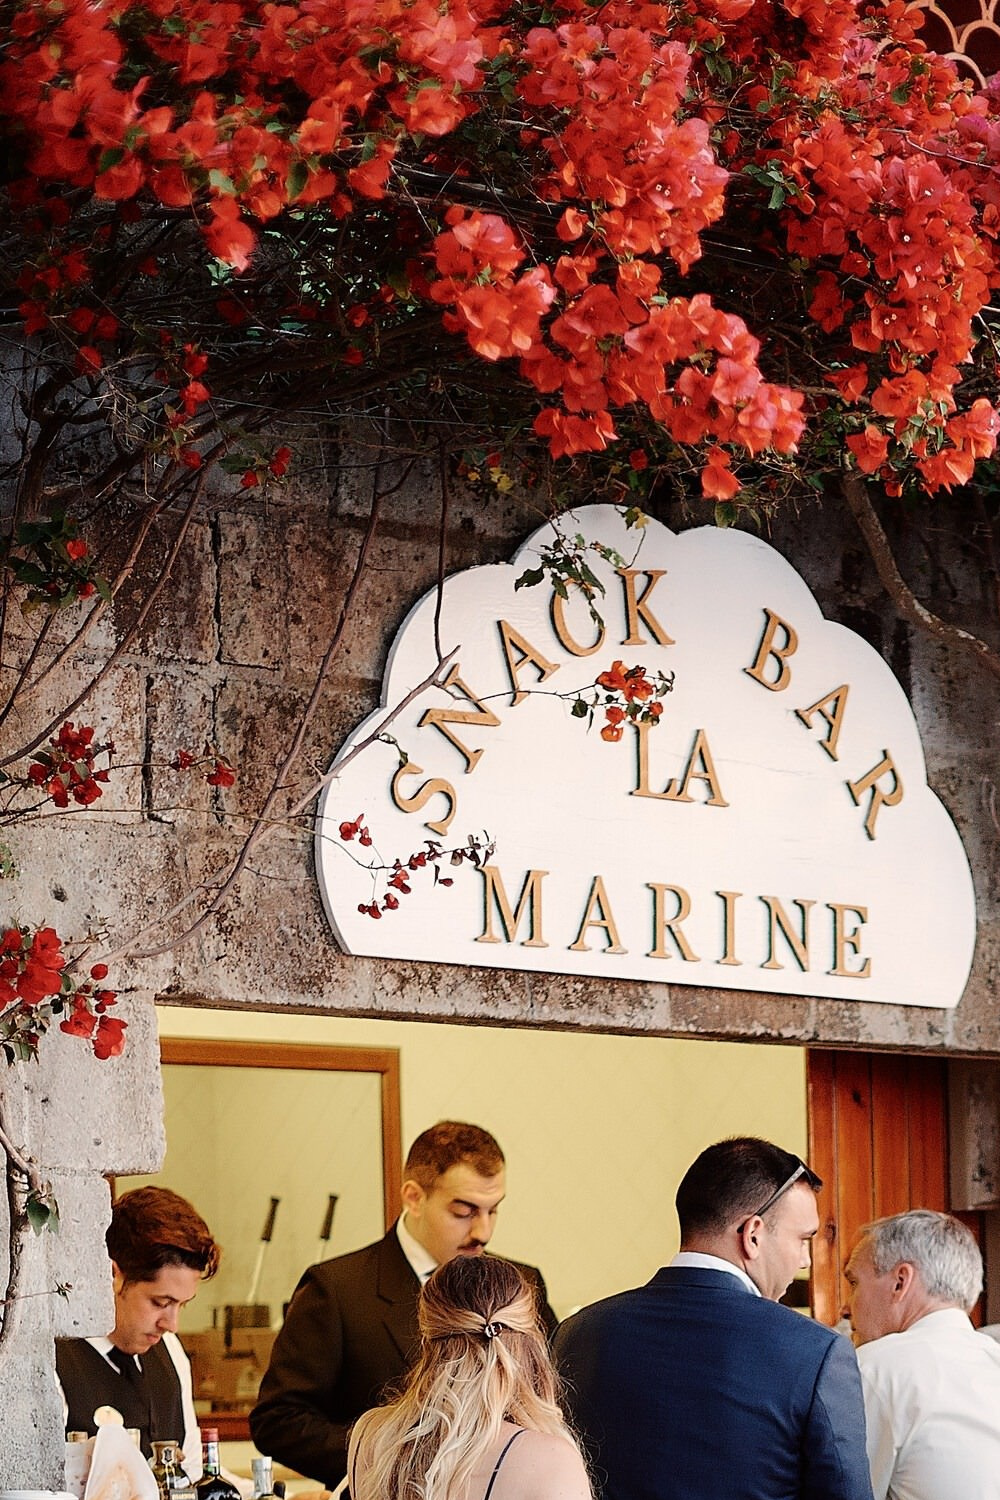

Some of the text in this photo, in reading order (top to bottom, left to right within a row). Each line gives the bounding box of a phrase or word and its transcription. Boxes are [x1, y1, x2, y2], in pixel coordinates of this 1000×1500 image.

[391, 570, 904, 840] SNACK BAR
[629, 718, 730, 808] LA
[474, 864, 872, 979] MARINE
